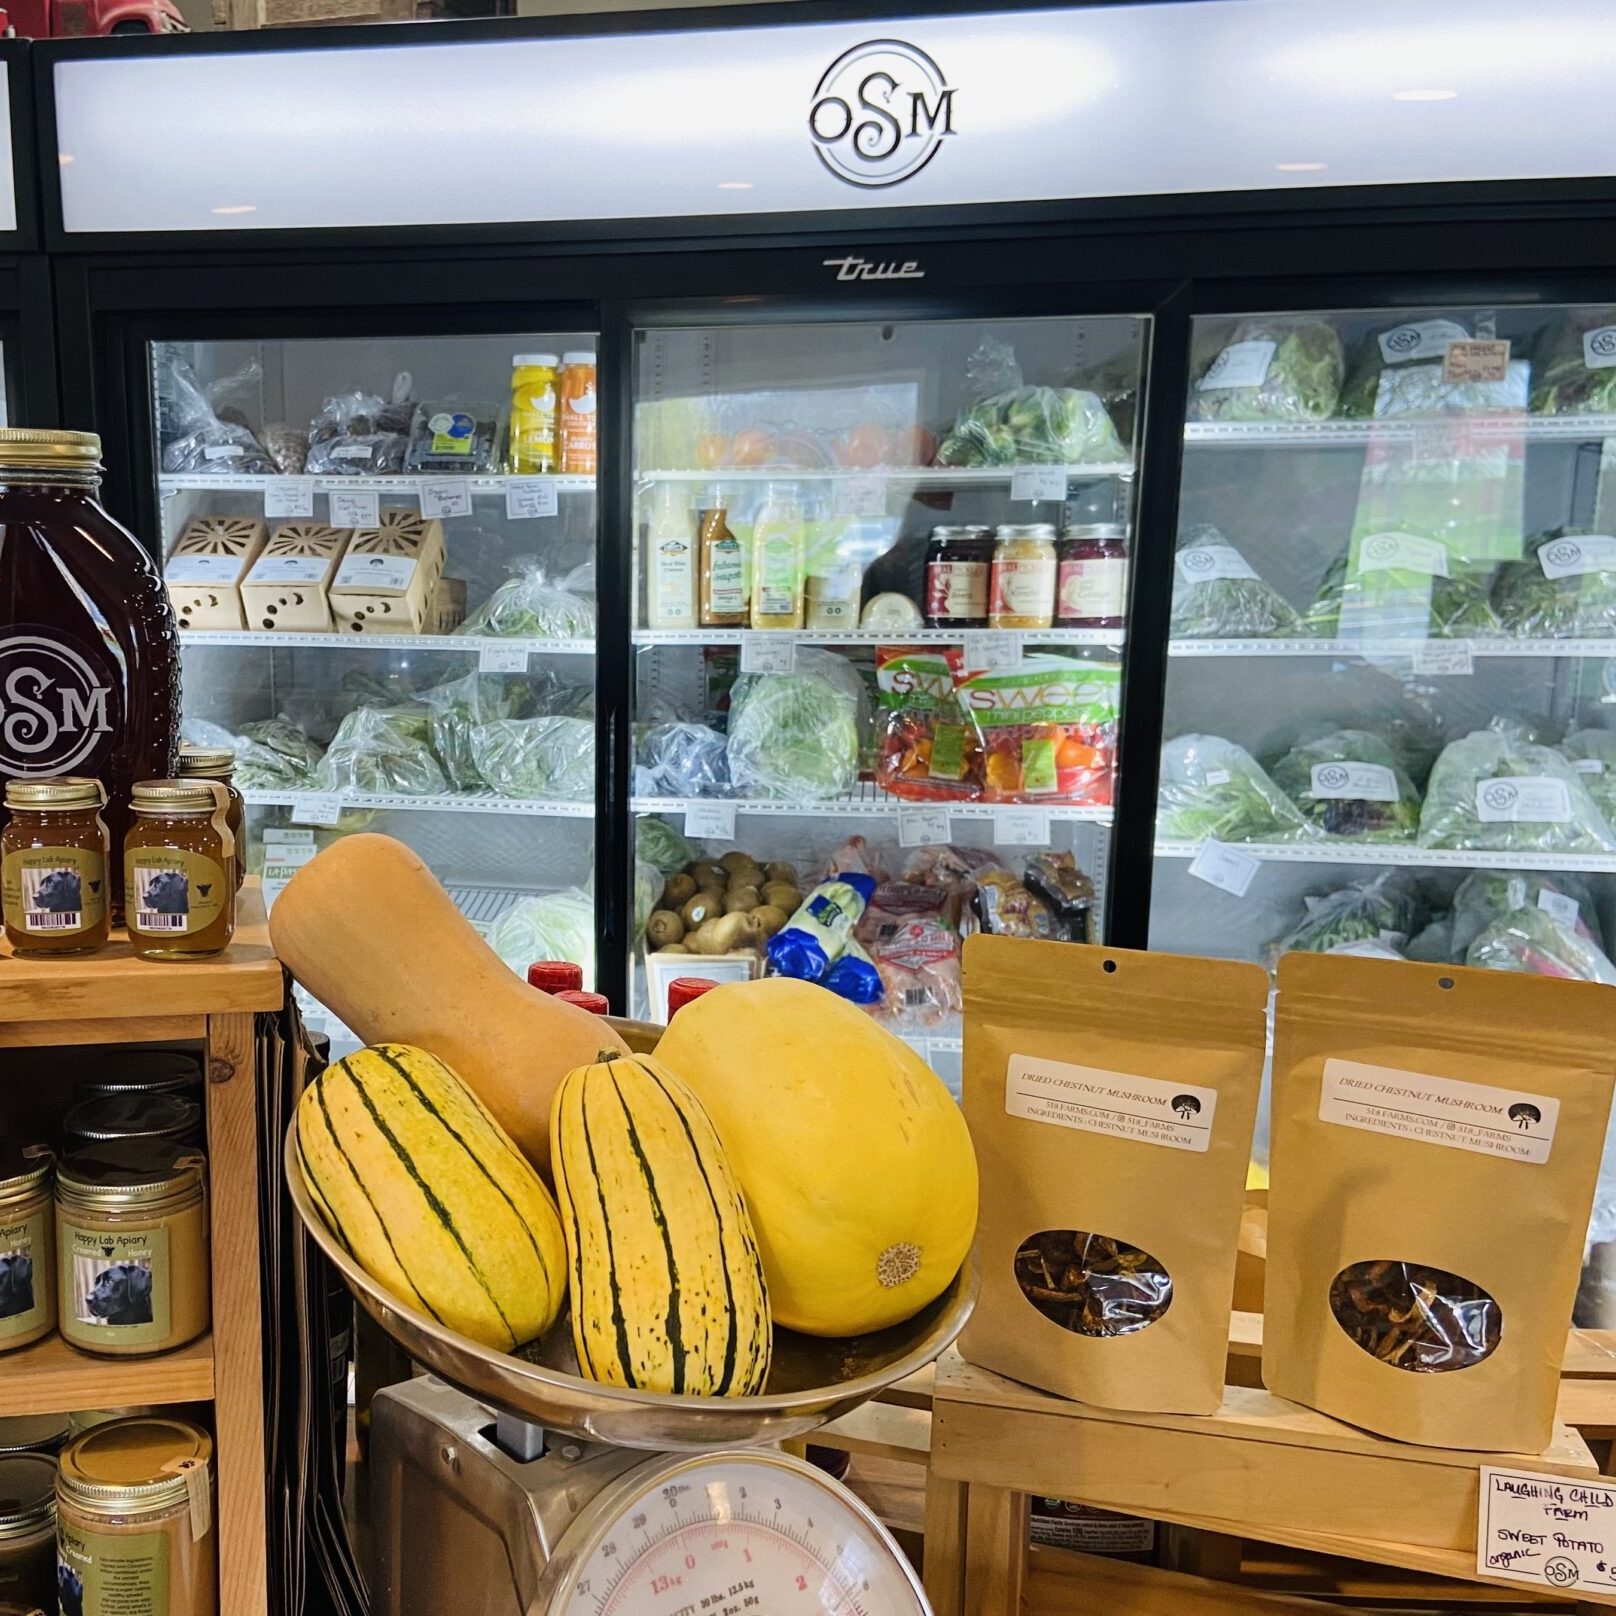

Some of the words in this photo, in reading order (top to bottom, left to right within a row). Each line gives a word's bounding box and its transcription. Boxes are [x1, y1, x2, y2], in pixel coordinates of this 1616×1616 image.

[808, 72, 959, 162] OSM
[822, 256, 925, 281] true
[0, 667, 113, 754] SM
[1021, 1072, 1052, 1085] DRIED
[1052, 1079, 1106, 1095] CHESTNUT
[1106, 1088, 1168, 1107] MUSHROOM
[1339, 1077, 1373, 1090] DRIED
[1373, 1084, 1435, 1102] CHESTNUT
[1434, 1094, 1504, 1115] MUSHROOM
[1088, 1119, 1138, 1135] CHESTNUT
[1137, 1128, 1192, 1145] MUSHROOM
[1414, 1126, 1469, 1144] CHESTNUT
[1468, 1137, 1531, 1156] MUSHROOM
[0, 1224, 27, 1240] Apiary
[75, 1231, 97, 1245] Happy
[99, 1235, 114, 1245] Lab
[116, 1236, 147, 1247] Apiary
[72, 1244, 102, 1257] Creamed
[127, 1249, 152, 1257] Honey
[739, 1486, 748, 1499] 2
[1495, 1478, 1564, 1504] LAUGHING
[1569, 1488, 1614, 1508] CHILD
[774, 1498, 782, 1510] 3
[1542, 1503, 1588, 1521] FARM
[632, 1513, 647, 1530] 29
[807, 1517, 814, 1529] 4
[601, 1541, 617, 1558] 28
[1497, 1529, 1547, 1546] SWEET
[1552, 1532, 1604, 1554] POTATO
[66, 1545, 93, 1564] Creamed
[685, 1554, 696, 1570] 0
[743, 1549, 752, 1562] 1
[1489, 1548, 1542, 1568] organic
[1544, 1562, 1580, 1582] OSM
[576, 1580, 591, 1596] 27
[796, 1574, 808, 1592] 2
